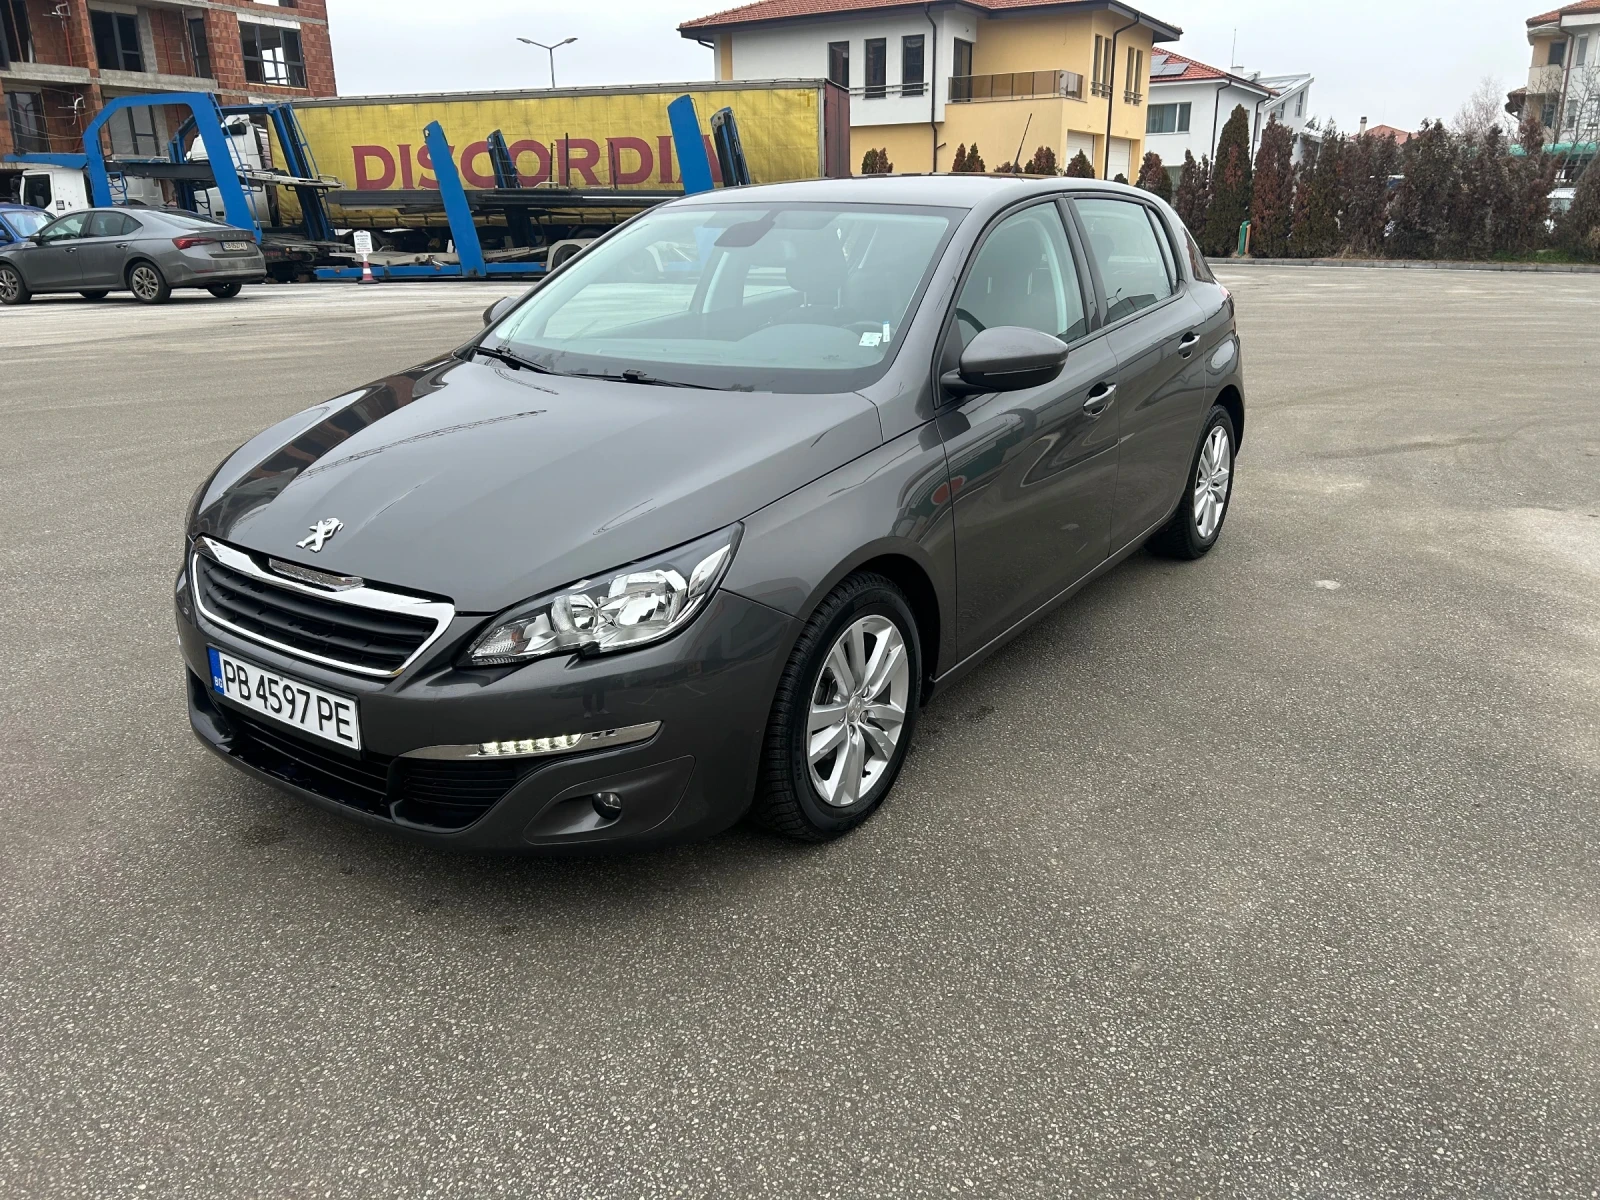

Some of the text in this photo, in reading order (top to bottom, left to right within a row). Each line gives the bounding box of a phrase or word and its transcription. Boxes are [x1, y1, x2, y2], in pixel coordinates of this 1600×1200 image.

[214, 675, 223, 688] BG
[223, 659, 353, 742] PB 4597 PE
